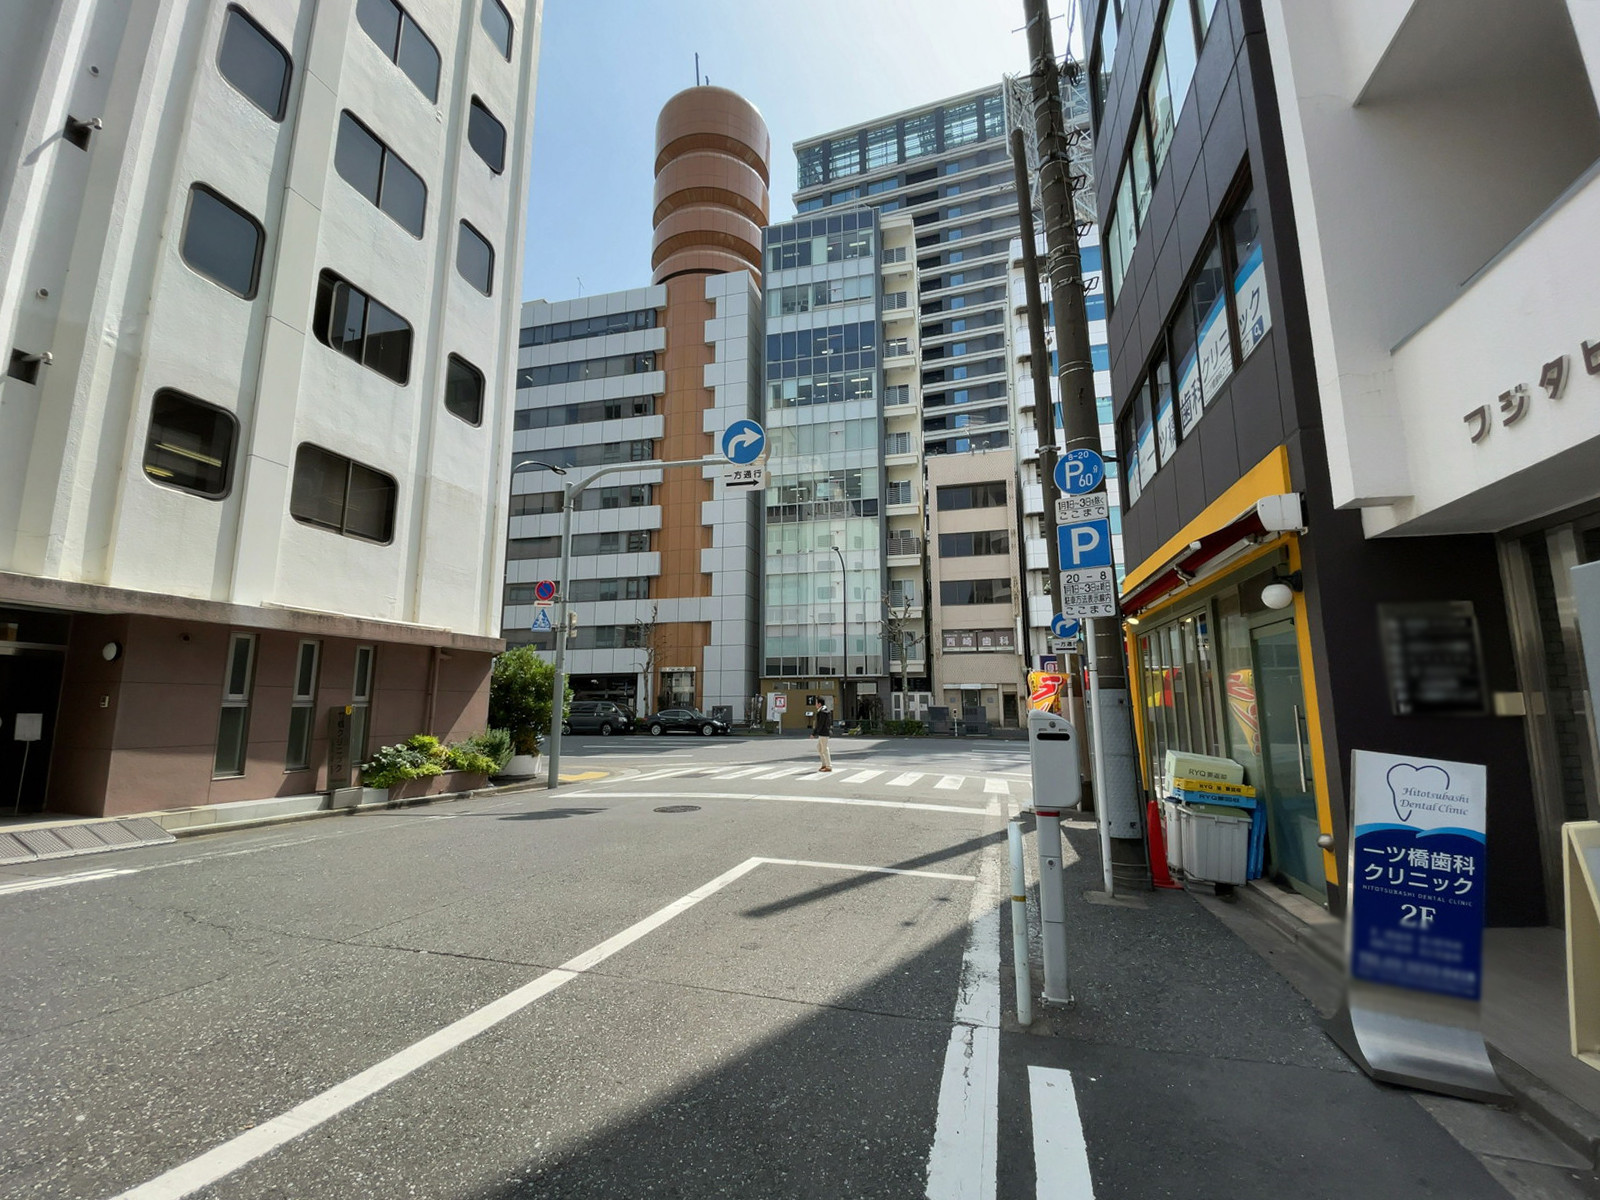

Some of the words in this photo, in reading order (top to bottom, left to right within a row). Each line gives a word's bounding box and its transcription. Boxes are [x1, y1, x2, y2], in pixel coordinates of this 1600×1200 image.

[1068, 451, 1089, 461] 8-20
[724, 469, 762, 480] 一方通行
[1065, 460, 1084, 489] P
[1079, 473, 1093, 487] 60
[1060, 506, 1105, 520] ここまで
[1071, 527, 1100, 565] P
[1066, 573, 1080, 584] 20
[1100, 571, 1107, 580] 8
[1066, 604, 1112, 616] ここまで
[1402, 787, 1469, 804] Hitotsubashi
[1400, 799, 1437, 811] Dental
[1438, 803, 1468, 815] Clinic
[1363, 846, 1475, 876] 一ツ橋歯科
[1365, 863, 1473, 894] クリニック
[1417, 893, 1446, 903] DENTAL
[1448, 898, 1473, 907] CLINIC
[1400, 903, 1436, 927] 2F
